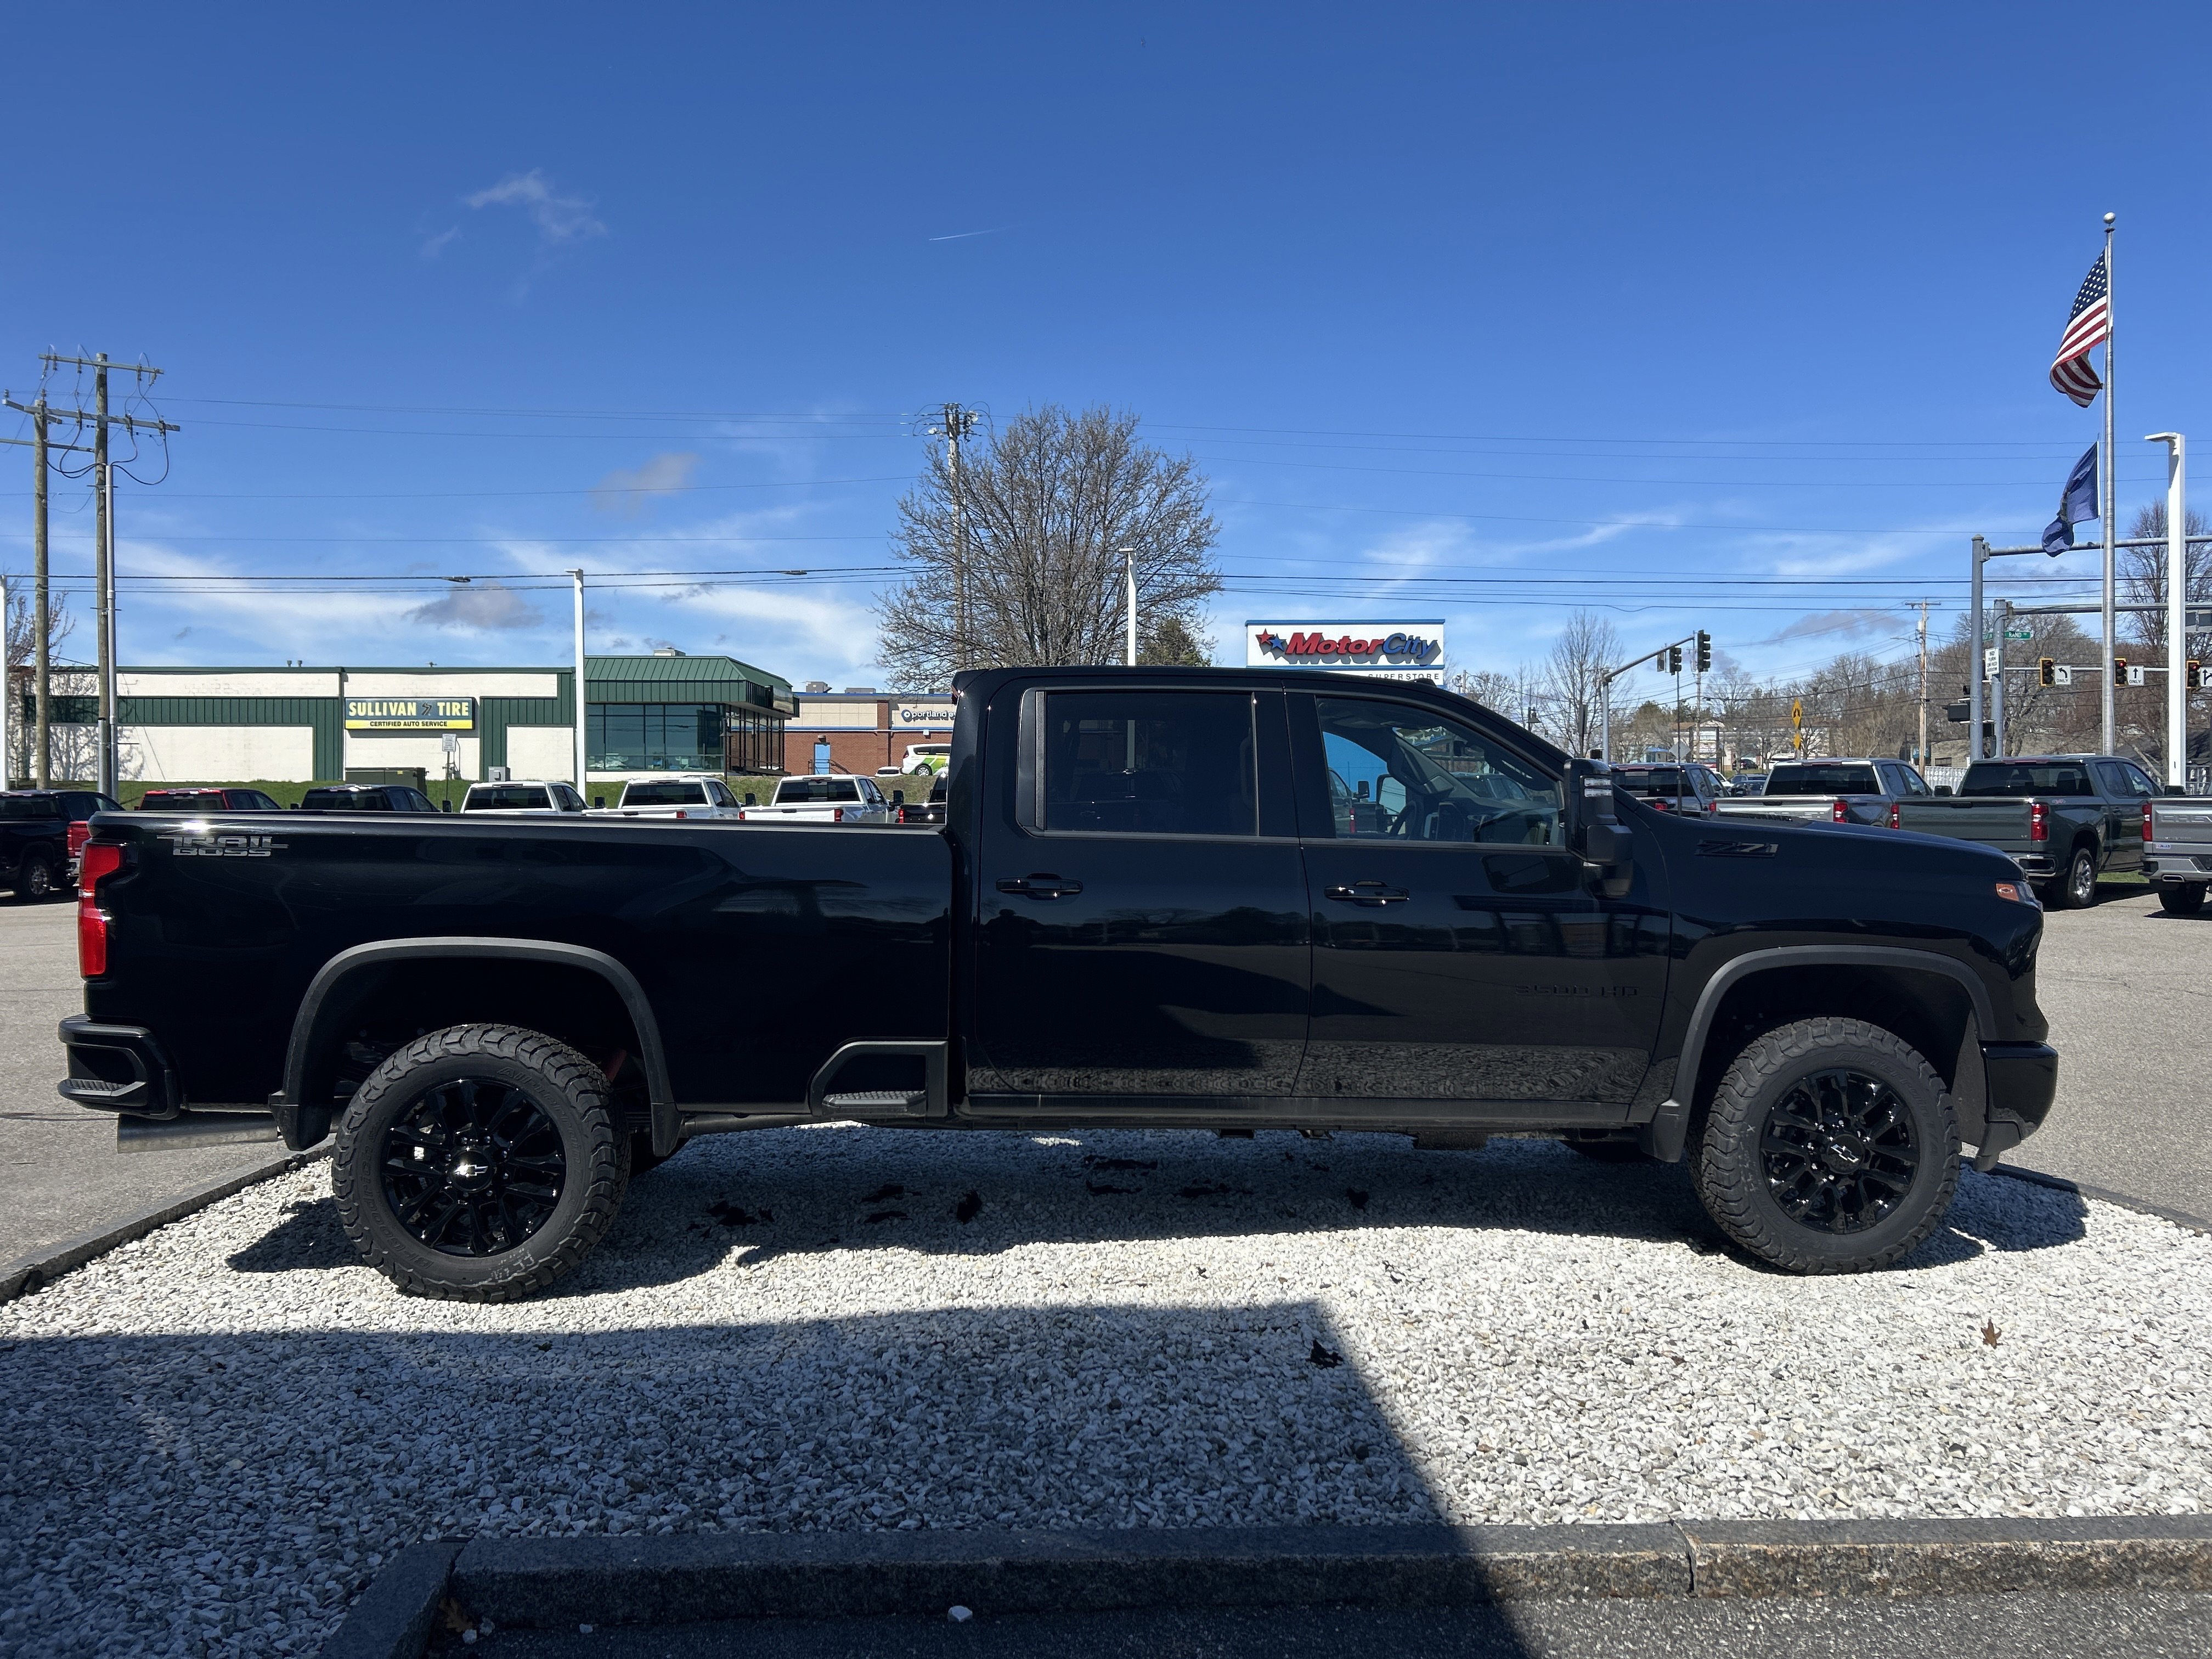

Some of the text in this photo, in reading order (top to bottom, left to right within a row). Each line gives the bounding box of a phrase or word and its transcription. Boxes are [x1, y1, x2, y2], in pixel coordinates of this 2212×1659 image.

[1285, 632, 1438, 659] MotorCity
[348, 702, 469, 716] SULLIVAN TIRE
[156, 835, 290, 849] TRAIL
[1694, 839, 1779, 859] Z71
[173, 848, 272, 856] BOSS
[1601, 985, 1640, 997] HD
